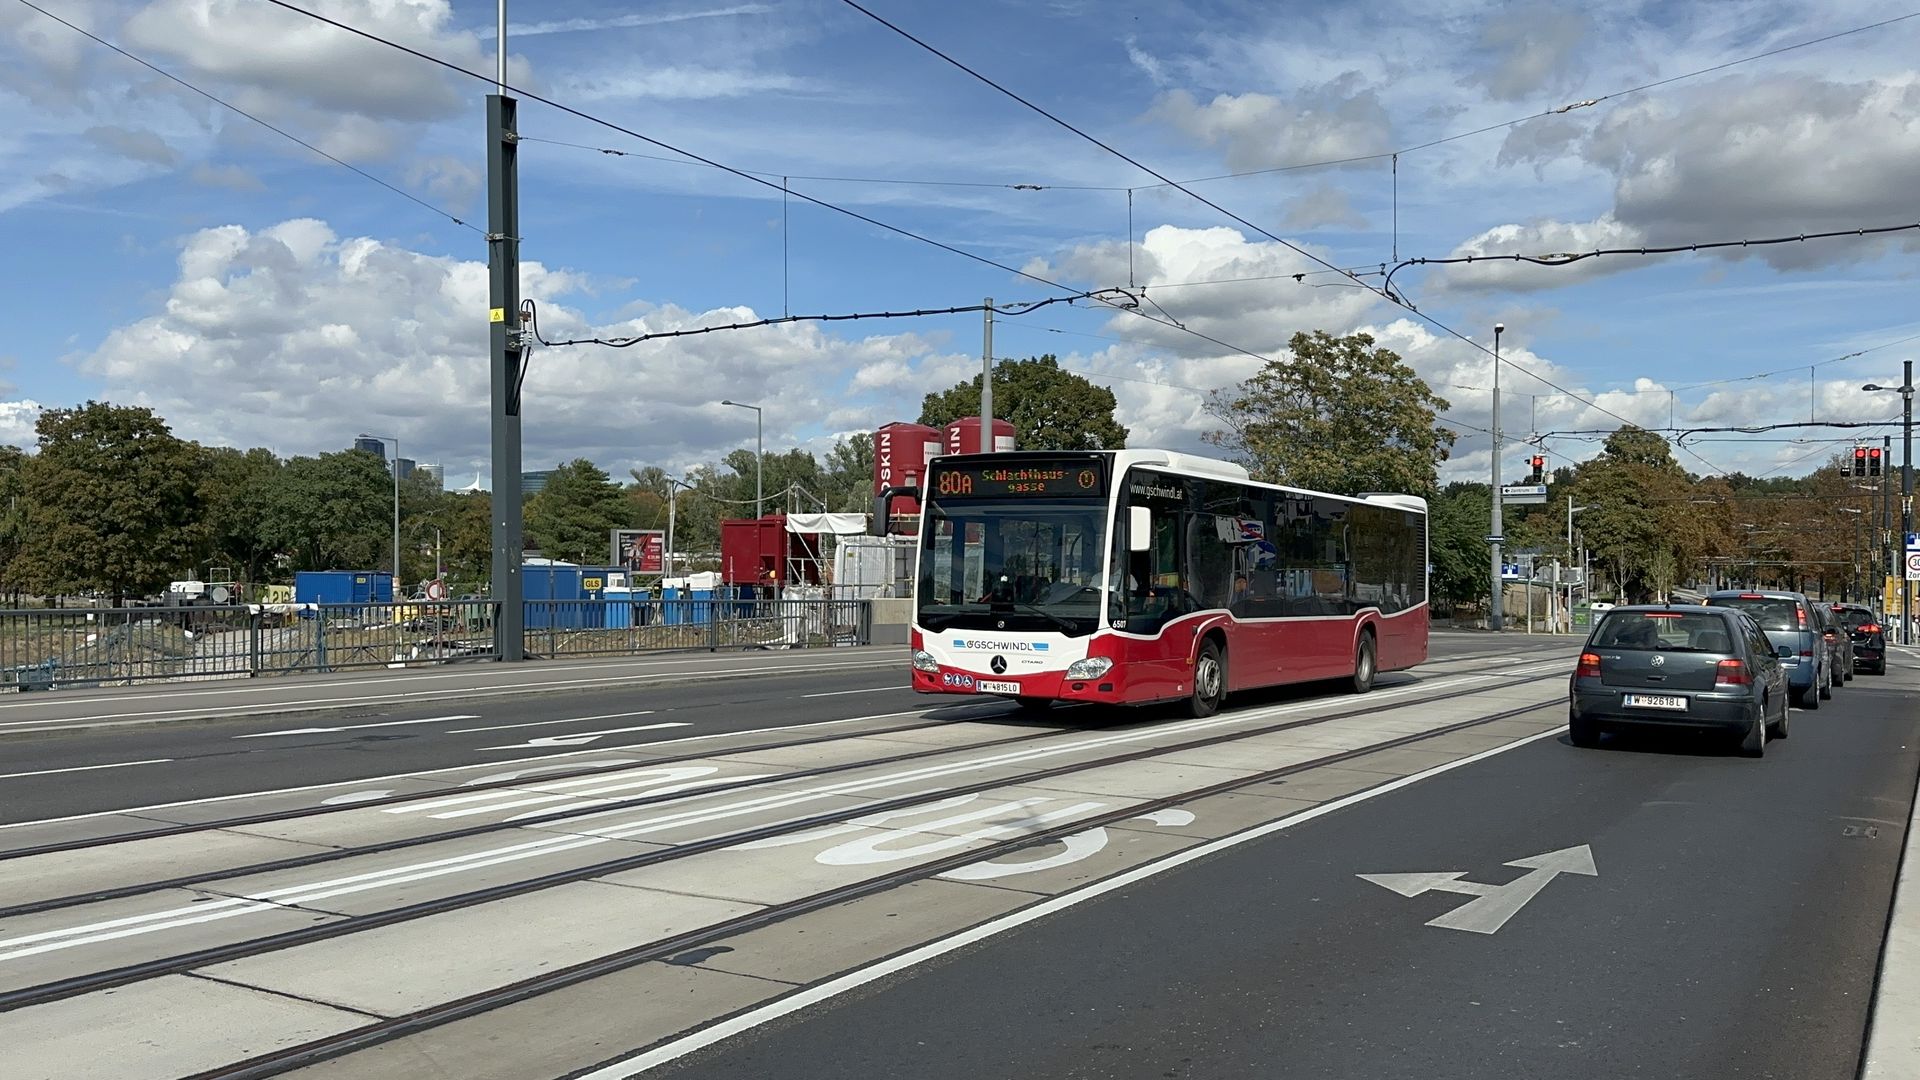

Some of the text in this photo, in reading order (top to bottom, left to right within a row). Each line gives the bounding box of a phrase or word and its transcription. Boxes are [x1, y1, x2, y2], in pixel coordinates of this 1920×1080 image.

[939, 471, 972, 494] 80A
[1008, 482, 1045, 493] gasse
[1129, 484, 1183, 500] www.gschwindl.at
[974, 640, 1033, 651] GSCHWINDL
